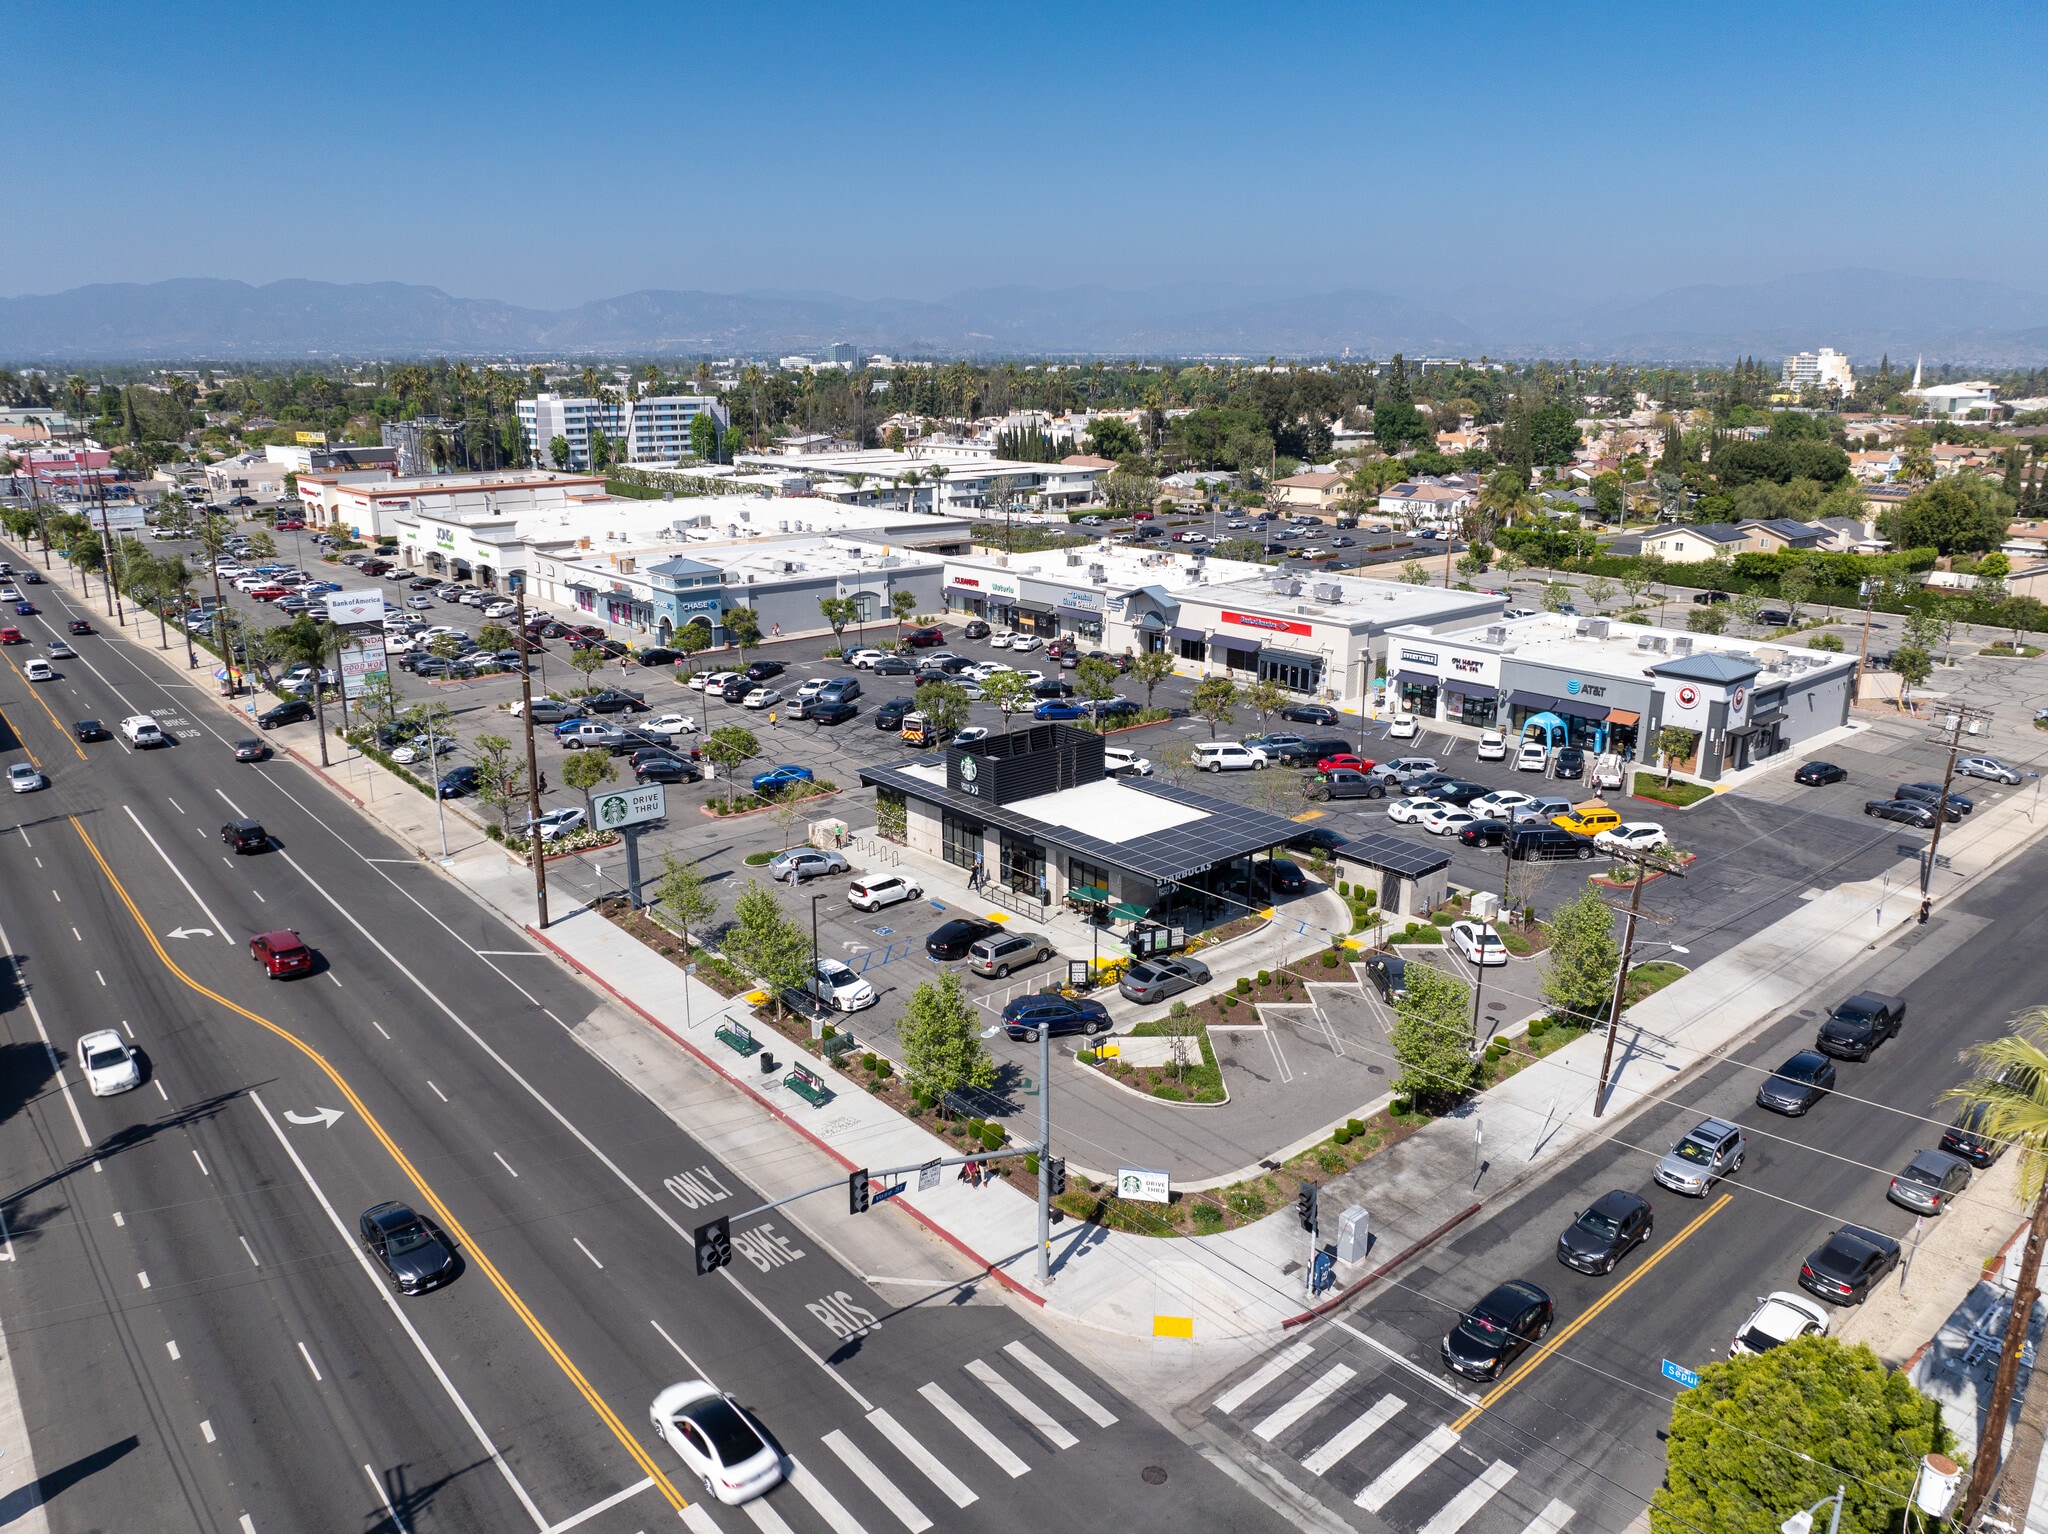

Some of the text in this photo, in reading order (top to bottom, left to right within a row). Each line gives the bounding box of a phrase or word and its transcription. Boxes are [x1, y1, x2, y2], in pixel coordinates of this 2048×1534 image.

[348, 598, 355, 606] of
[355, 597, 380, 605] America
[1072, 591, 1093, 602] Dental
[683, 601, 708, 611] CHASE
[1062, 598, 1077, 607] Care
[1077, 601, 1098, 611] Center
[343, 663, 366, 672] GOOD
[1580, 684, 1607, 698] AT&T
[150, 708, 177, 716] ONLY
[162, 718, 190, 727] BIKE
[175, 729, 201, 738] BUS
[633, 794, 658, 805] DRIVE
[635, 803, 658, 814] THRU
[1157, 863, 1212, 886] STARBUCKS
[663, 1165, 733, 1209] ONLY
[730, 1223, 806, 1273] BIKE
[805, 1290, 882, 1343] BUS
